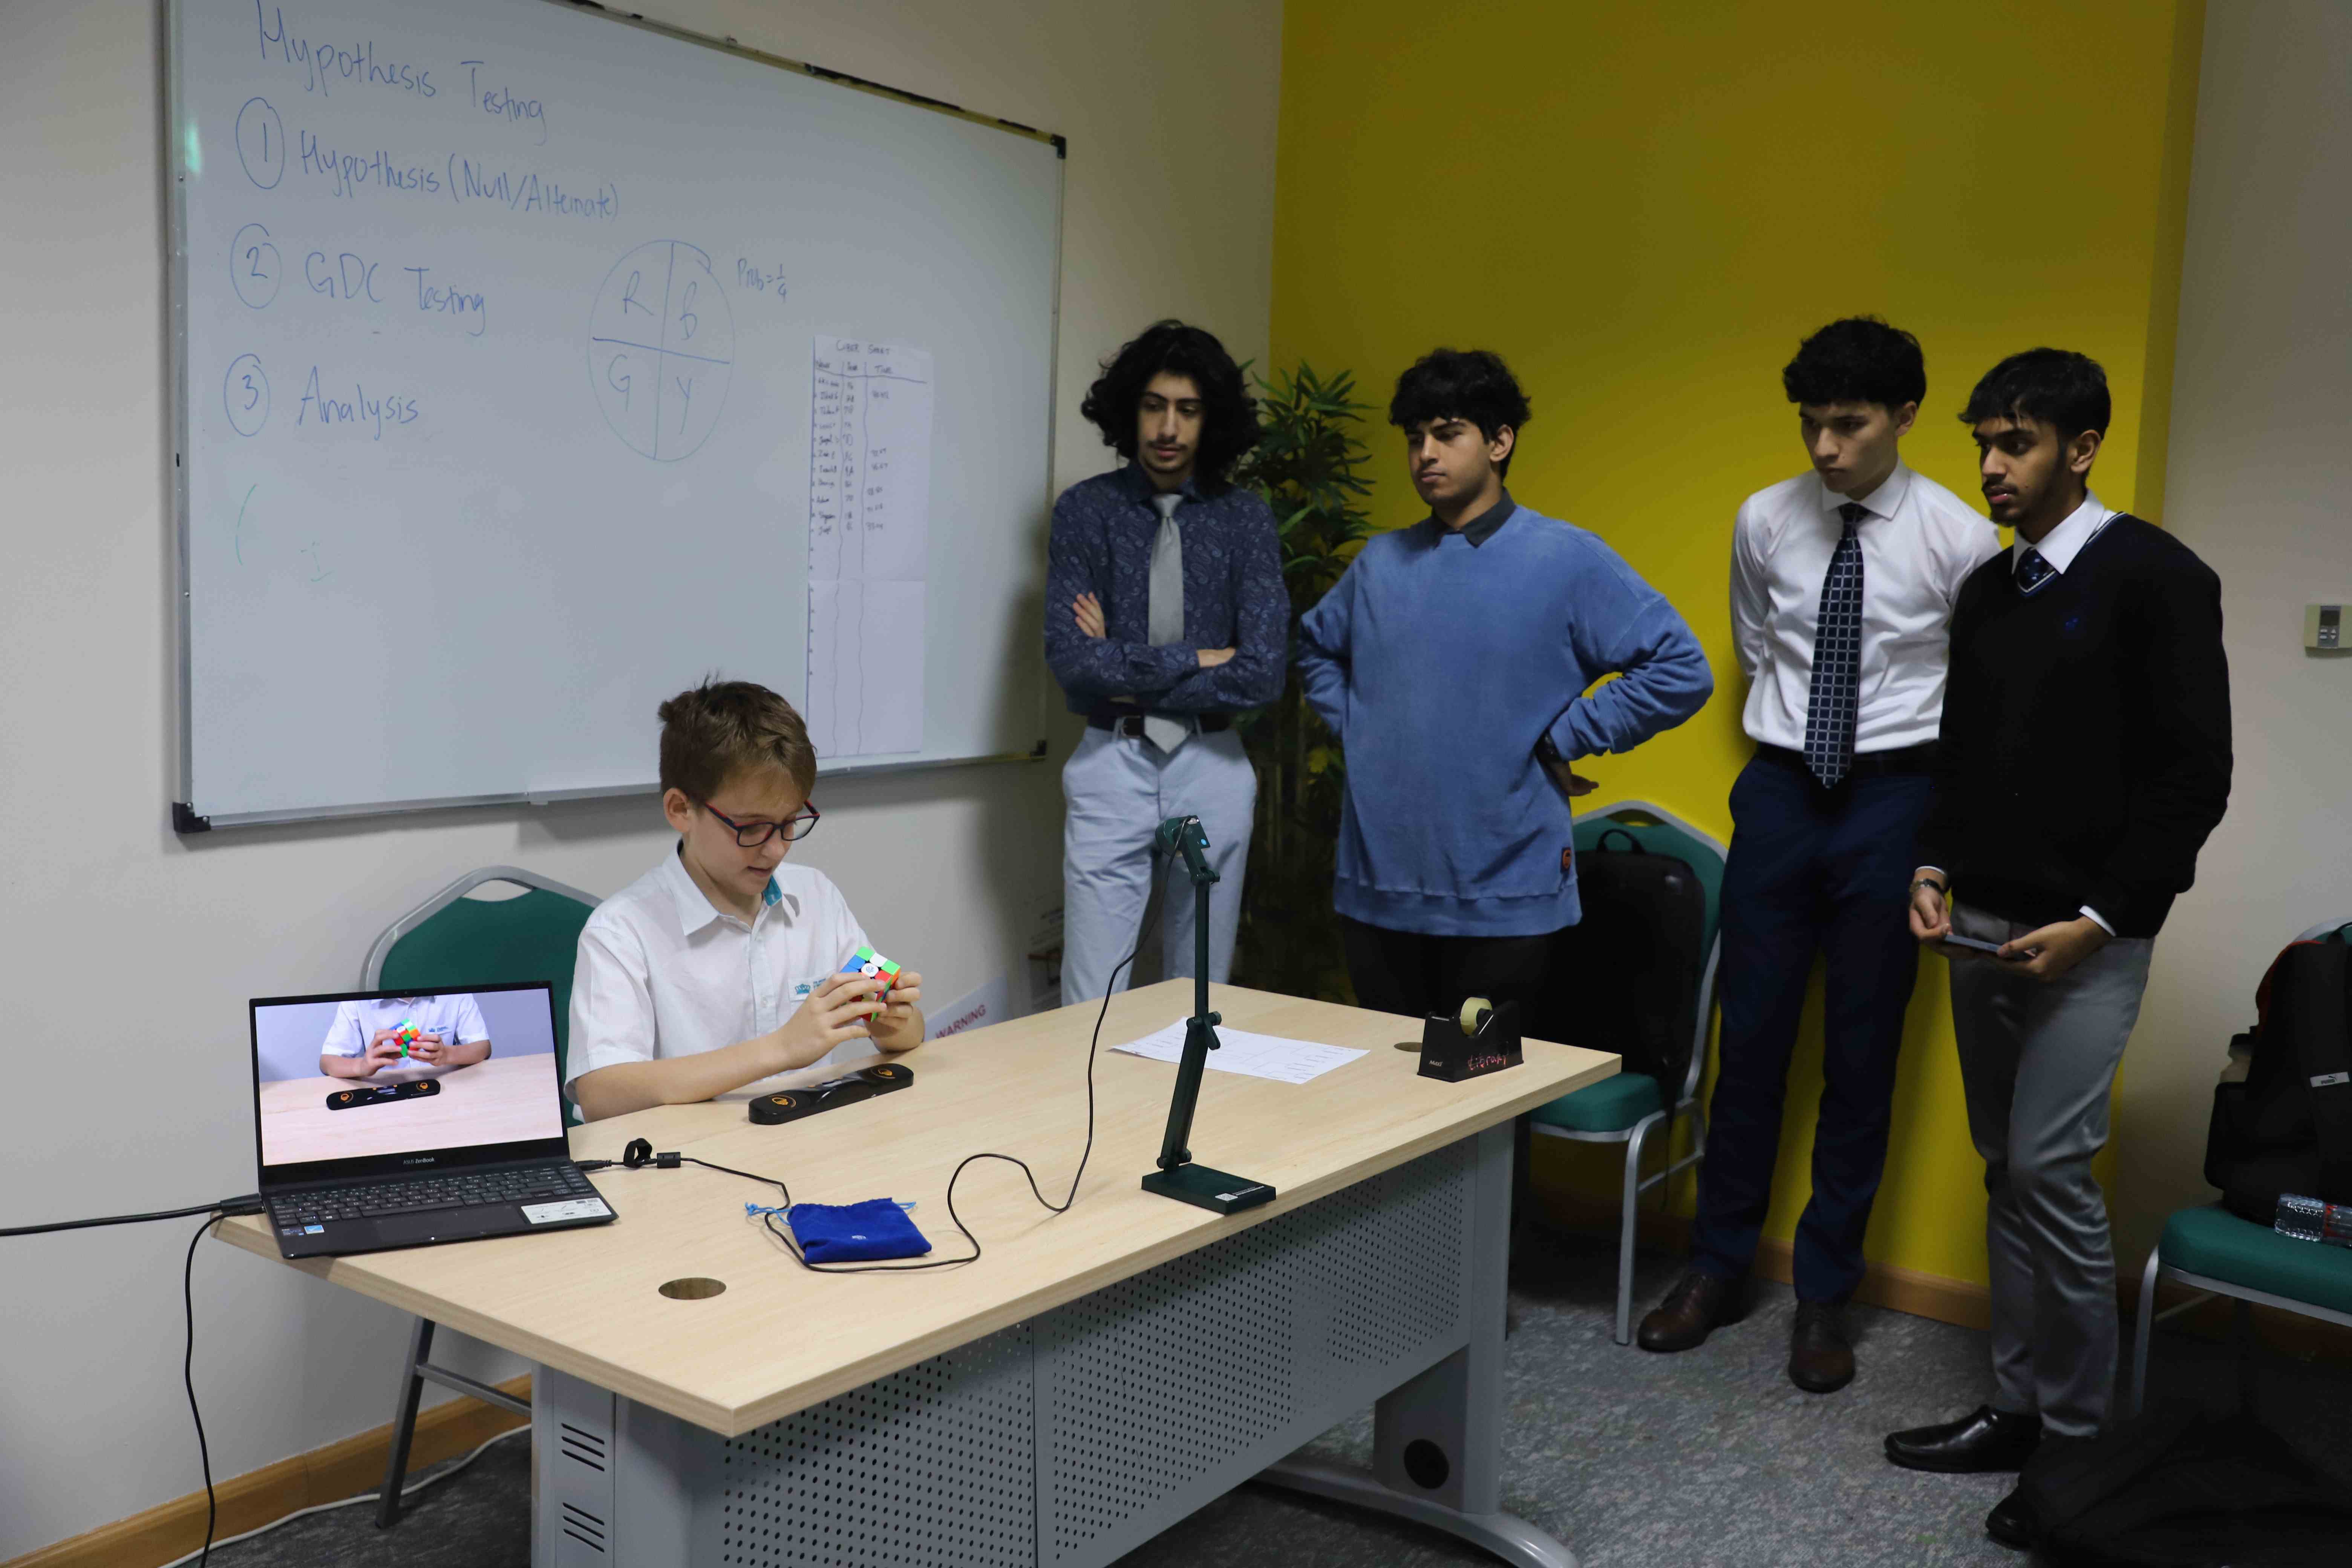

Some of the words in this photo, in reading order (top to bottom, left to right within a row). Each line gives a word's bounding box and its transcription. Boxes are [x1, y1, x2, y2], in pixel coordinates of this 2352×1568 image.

[256, 0, 436, 97] Hypothesis
[461, 60, 547, 146] Testing
[301, 129, 440, 199] Hypothesis
[305, 251, 383, 303] GDC
[404, 266, 486, 337] Testing
[622, 270, 655, 316] R
[298, 365, 419, 441] Analysis
[936, 1004, 986, 1039] WARNING
